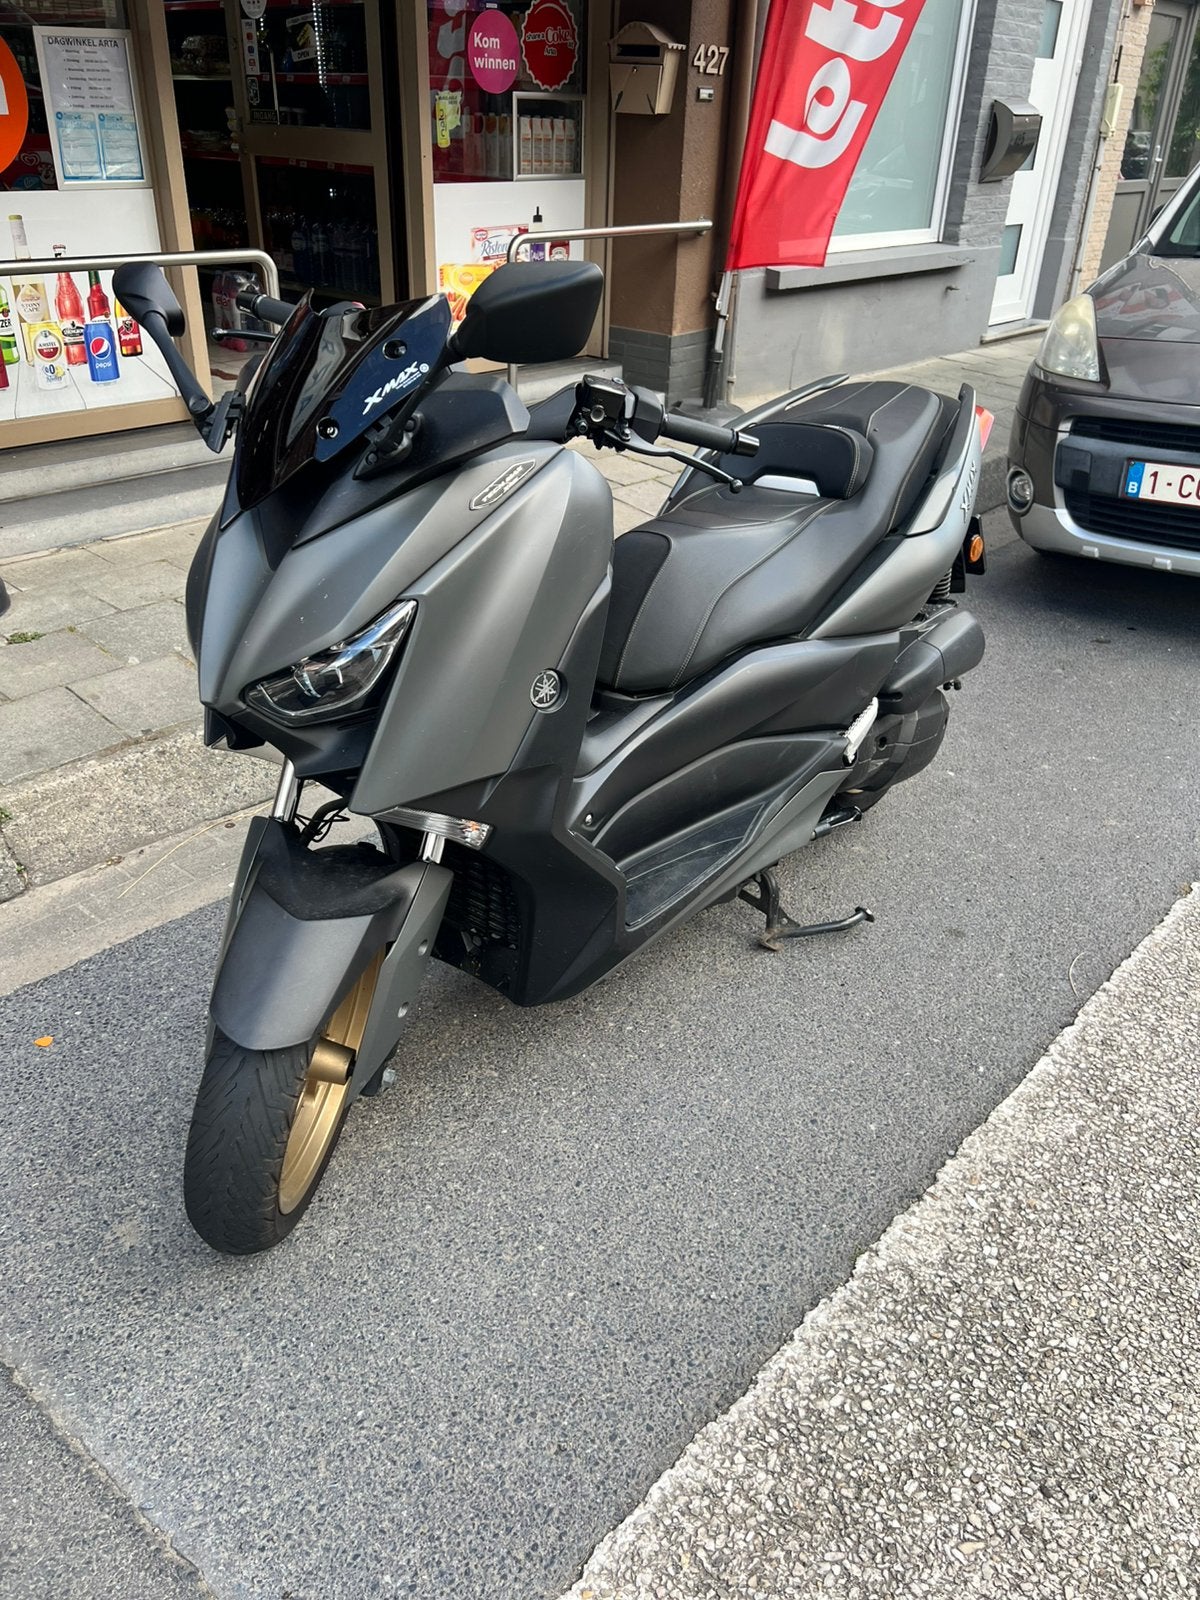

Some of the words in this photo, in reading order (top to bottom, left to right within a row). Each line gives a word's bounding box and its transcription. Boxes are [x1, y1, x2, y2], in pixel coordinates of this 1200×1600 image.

[47, 36, 97, 47] DAGWINKEL
[98, 39, 119, 49] ARTA
[474, 32, 500, 49] Kom
[545, 26, 572, 45] Coke
[297, 51, 310, 59] OPEN
[474, 53, 516, 70] winnen
[693, 43, 730, 76] 427
[763, 0, 905, 169] Lot
[95, 361, 112, 369] pepsi
[1127, 481, 1138, 494] B
[1149, 470, 1200, 501] 1-C
